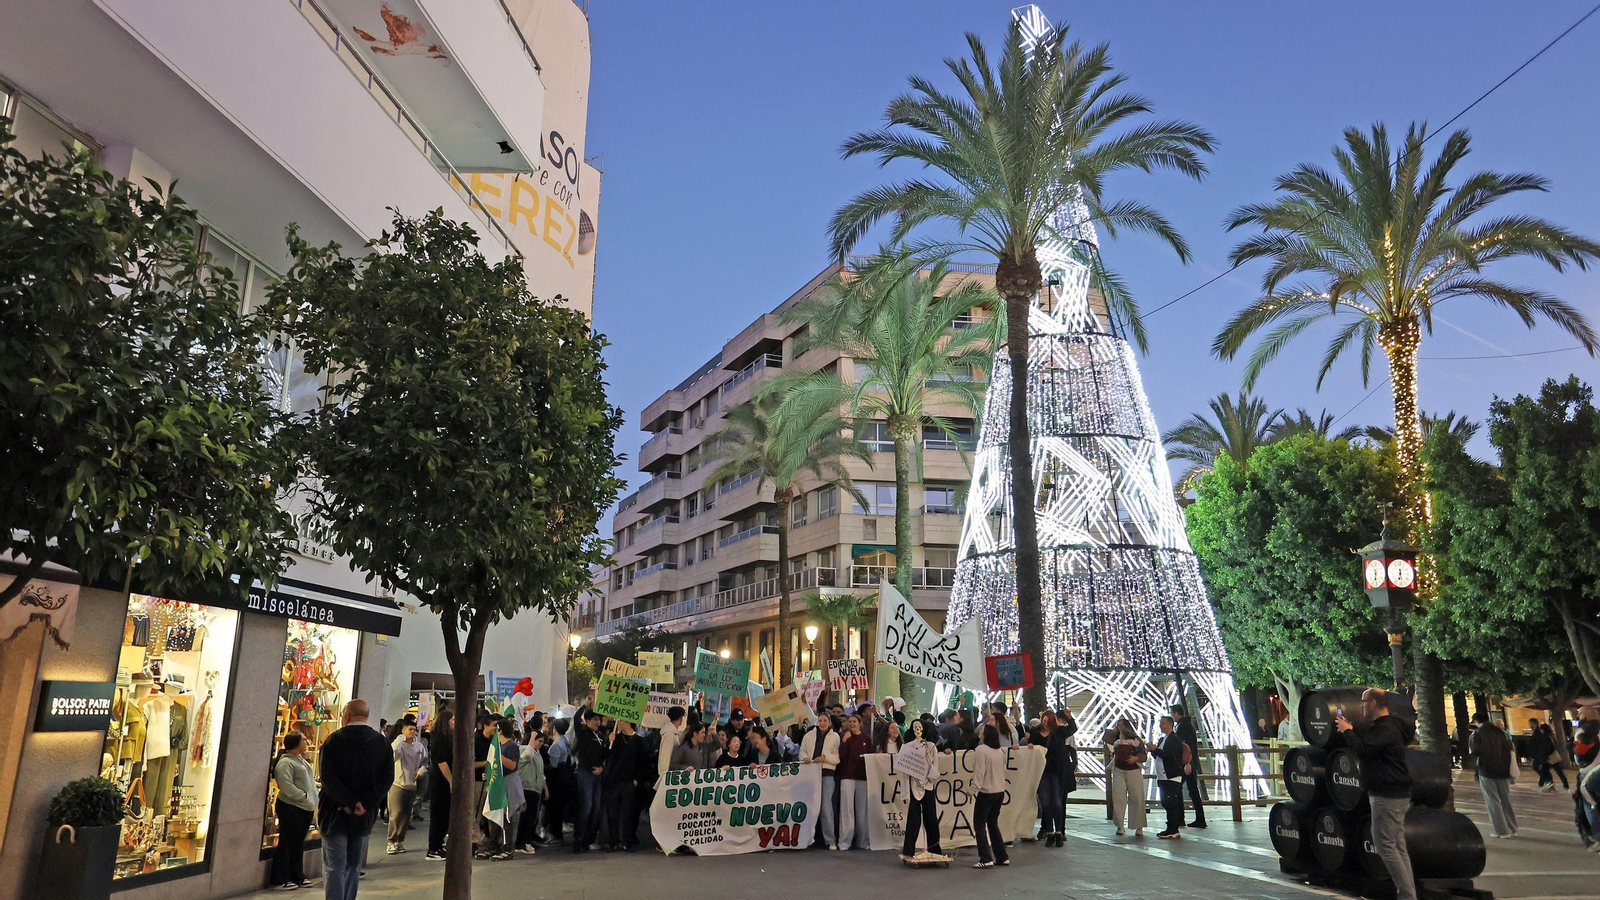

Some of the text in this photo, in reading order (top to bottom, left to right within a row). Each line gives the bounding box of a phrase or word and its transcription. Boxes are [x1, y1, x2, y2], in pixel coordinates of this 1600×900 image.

[553, 180, 573, 210] con
[450, 171, 577, 270] EREZ
[247, 593, 335, 623] miscelánea
[885, 625, 964, 675] DIGNAS
[828, 659, 858, 669] EDIFICIO
[899, 660, 922, 675] LOLA
[926, 668, 962, 683] FLORES
[839, 667, 866, 677] NUEVO
[604, 679, 650, 695] 14 AÑOS
[625, 690, 636, 699] DE
[52, 698, 111, 709] BOLSOS PATRI
[608, 695, 637, 708] FALSAS
[596, 702, 641, 720] PROMESAS
[664, 770, 691, 786] IES
[694, 764, 735, 785] LOLA
[1290, 771, 1315, 786] Canasta
[1332, 772, 1360, 788] Canasta
[664, 782, 761, 809] EDIFICIO
[681, 810, 717, 822] POR UNA
[729, 801, 808, 828] NUEVO
[886, 812, 904, 822] IES
[677, 818, 723, 831] EDUCACIÓN
[1275, 825, 1300, 839] Canasta
[683, 827, 717, 839] PÚBLICA
[689, 834, 725, 847] CALIDAD
[757, 823, 802, 849] YA!
[1317, 832, 1344, 847] Canasta
